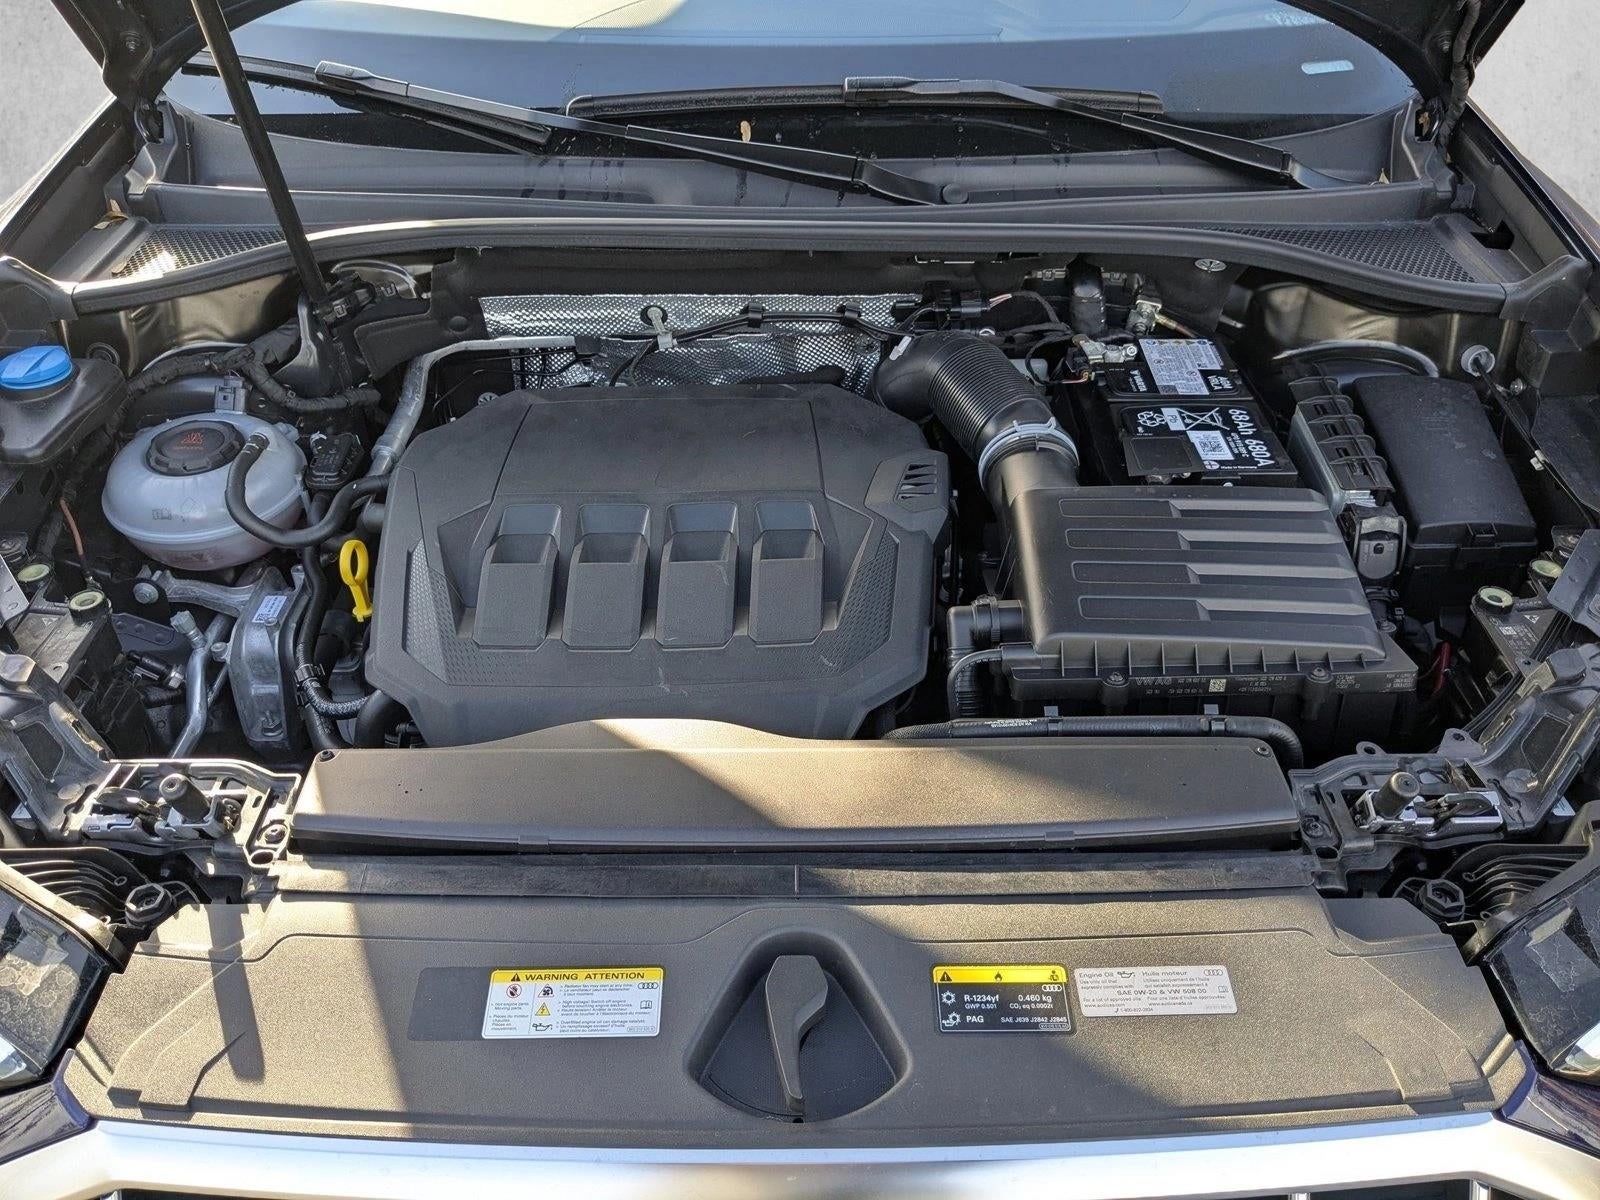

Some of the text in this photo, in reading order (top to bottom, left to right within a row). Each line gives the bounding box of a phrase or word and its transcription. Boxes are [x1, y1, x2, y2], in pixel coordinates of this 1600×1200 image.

[1228, 409, 1275, 467] 68Ah 680A
[525, 972, 645, 981] WARNING ATTENTION
[964, 994, 1000, 1004] R-1234yf
[1042, 994, 1052, 1003] kg
[966, 1015, 985, 1023] PAG
